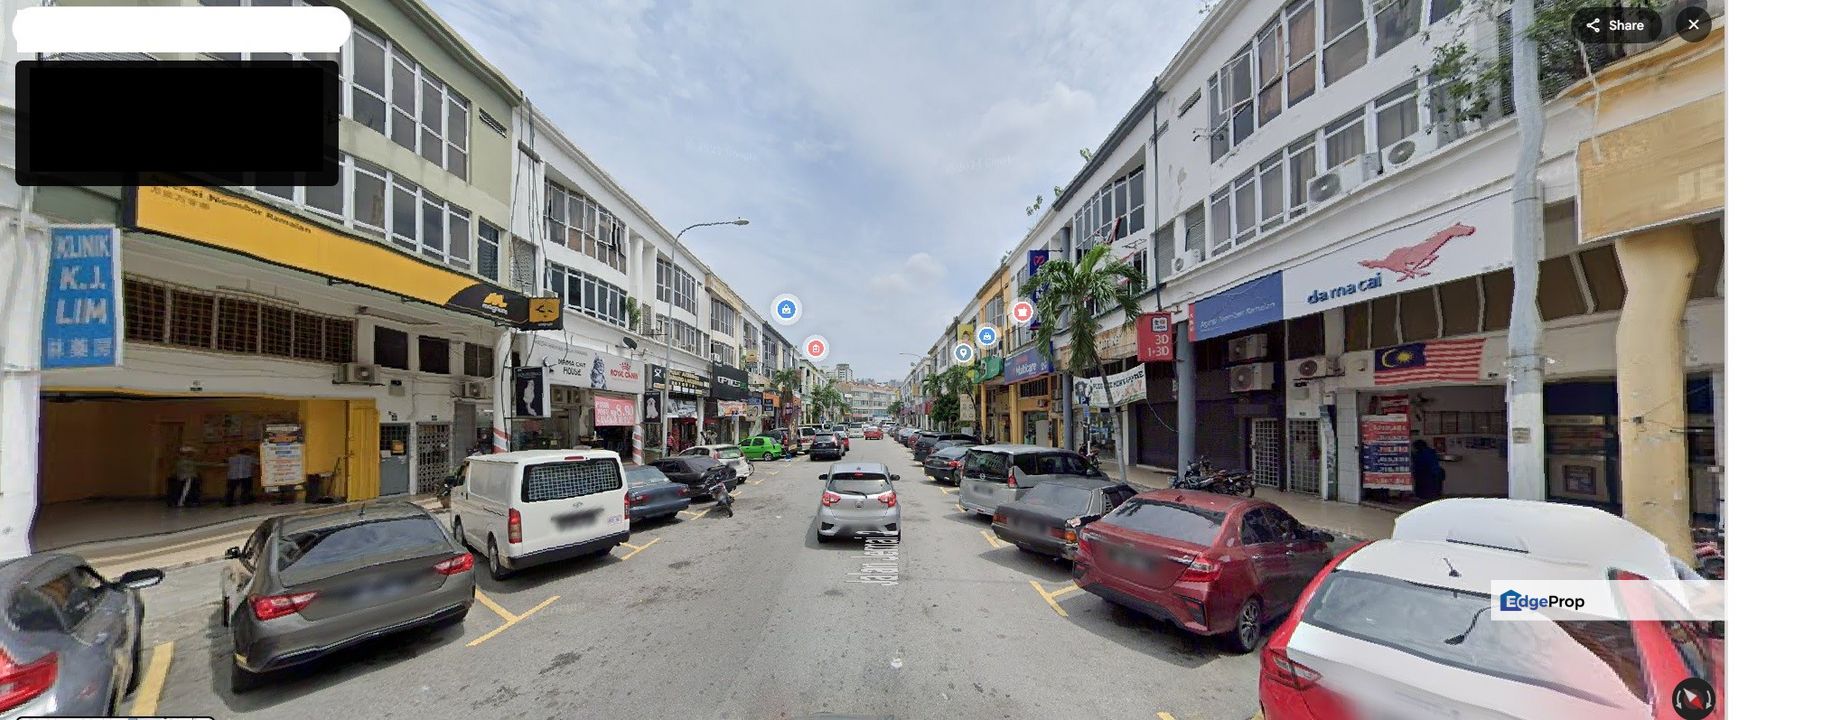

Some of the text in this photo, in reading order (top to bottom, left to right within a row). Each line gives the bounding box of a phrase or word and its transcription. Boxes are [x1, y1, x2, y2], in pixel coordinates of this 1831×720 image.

[54, 234, 110, 258] KLINIK
[56, 298, 107, 325] LIM
[1154, 334, 1169, 345] 3D
[563, 366, 582, 376] HOUSE
